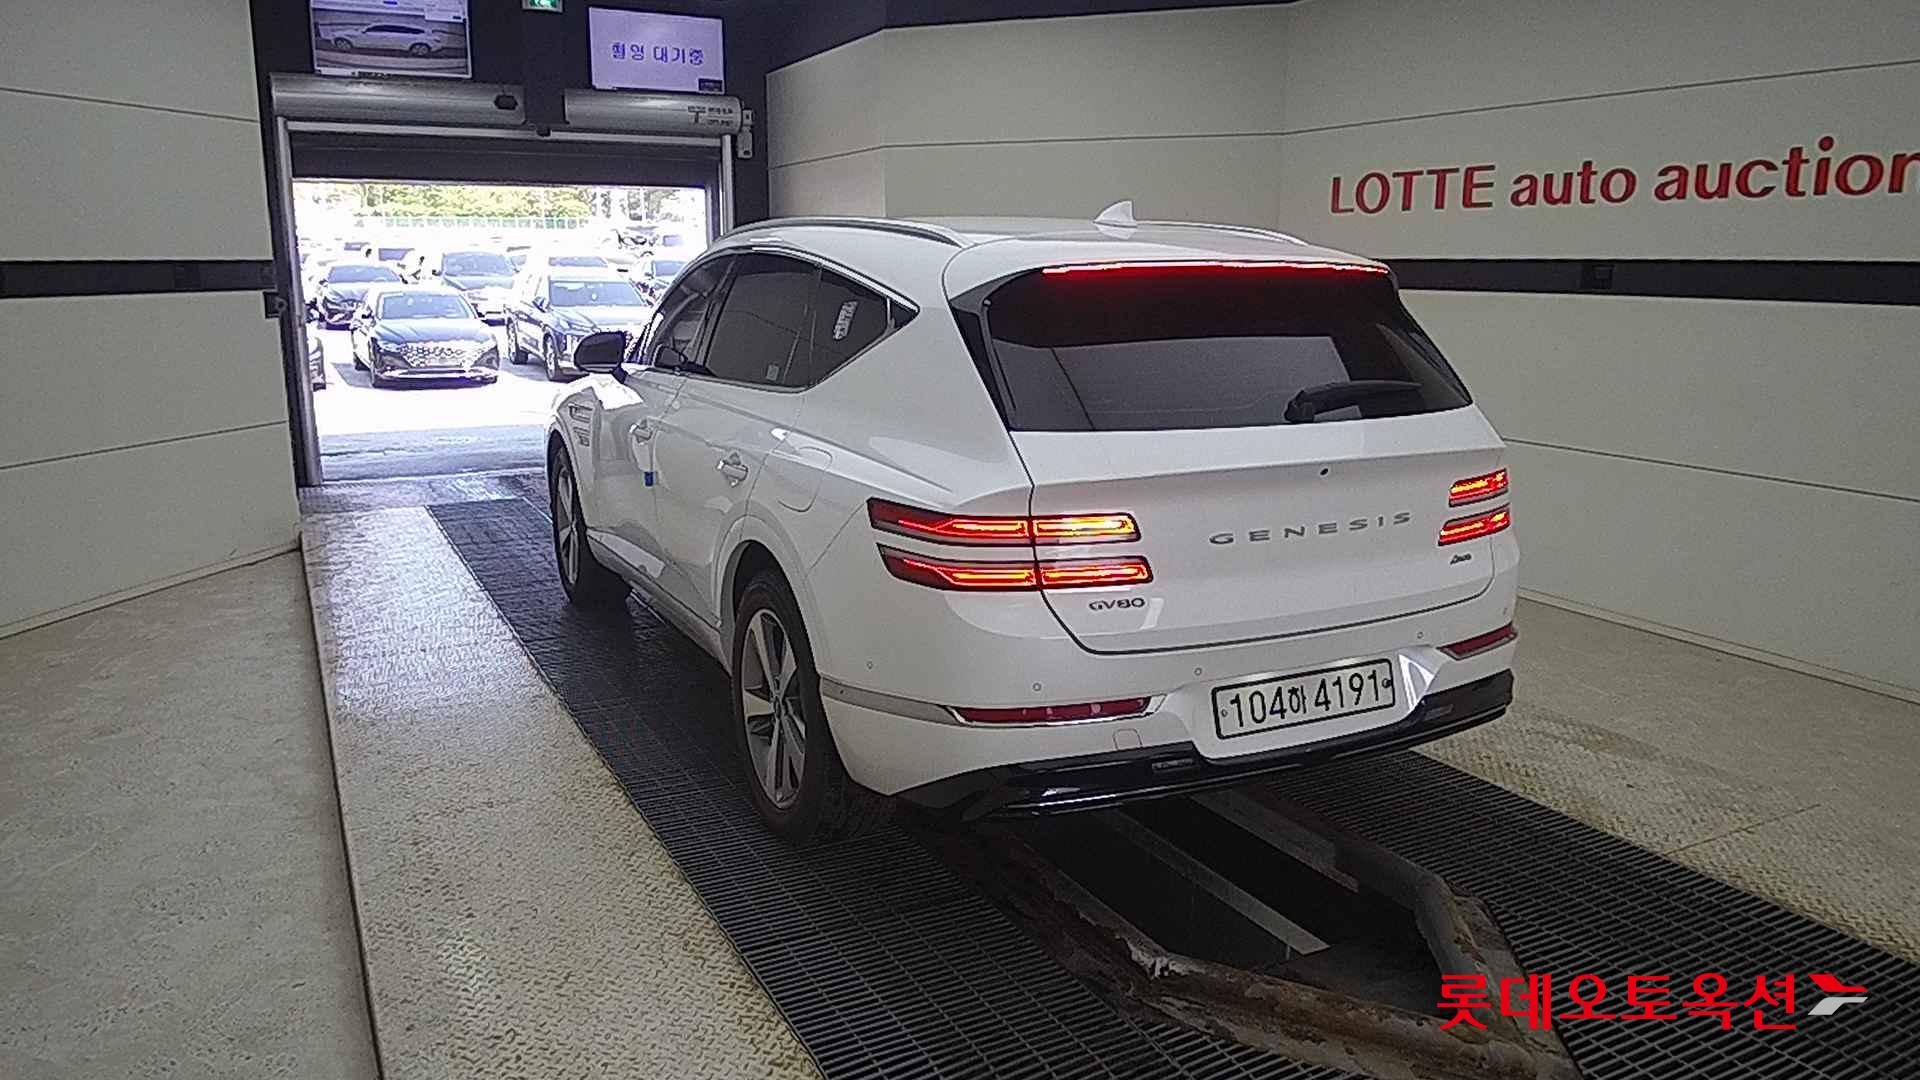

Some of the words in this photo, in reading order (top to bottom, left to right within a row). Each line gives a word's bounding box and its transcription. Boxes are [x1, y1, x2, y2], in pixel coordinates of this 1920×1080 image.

[1330, 165, 1496, 214] LOTTE
[1510, 161, 1637, 206] auto
[1209, 512, 1411, 545] GENESIS
[1089, 597, 1146, 611] GV80
